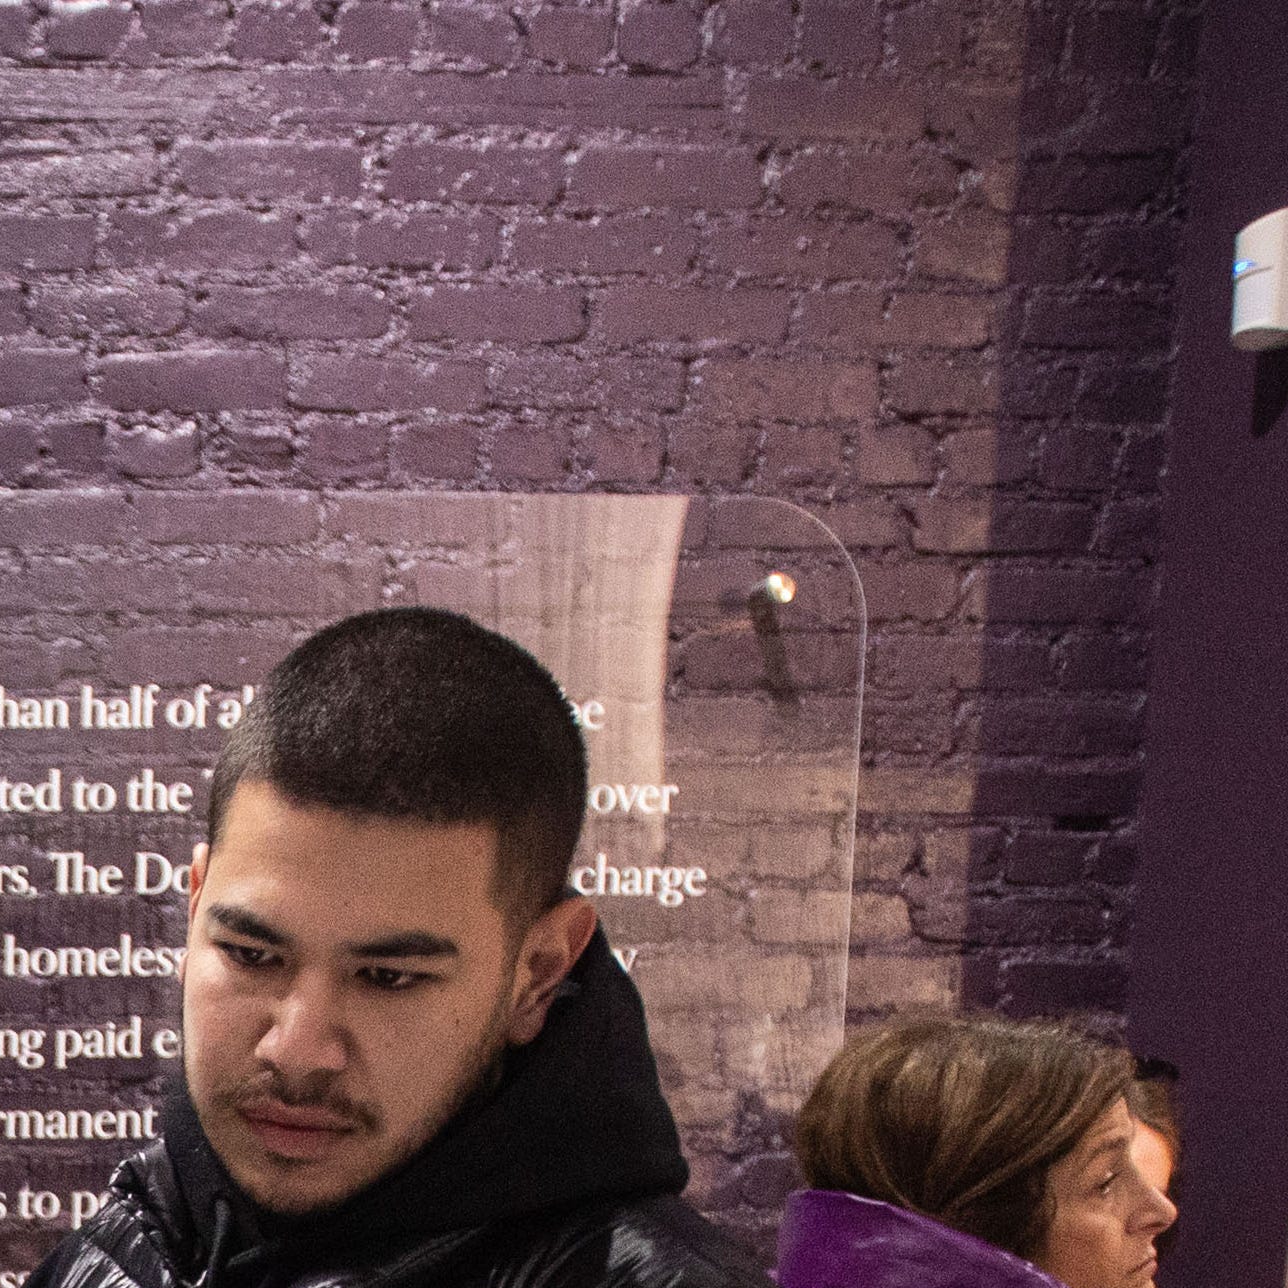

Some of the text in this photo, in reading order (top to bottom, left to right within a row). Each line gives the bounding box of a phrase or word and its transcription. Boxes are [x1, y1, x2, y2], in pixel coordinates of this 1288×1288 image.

[80, 684, 160, 730] half
[166, 684, 213, 730] of
[73, 776, 117, 813] to
[127, 768, 193, 813] the
[590, 782, 679, 815] over
[49, 851, 124, 896] The
[574, 853, 708, 908] charge
[54, 1015, 141, 1070] paid
[18, 1185, 62, 1221] to
